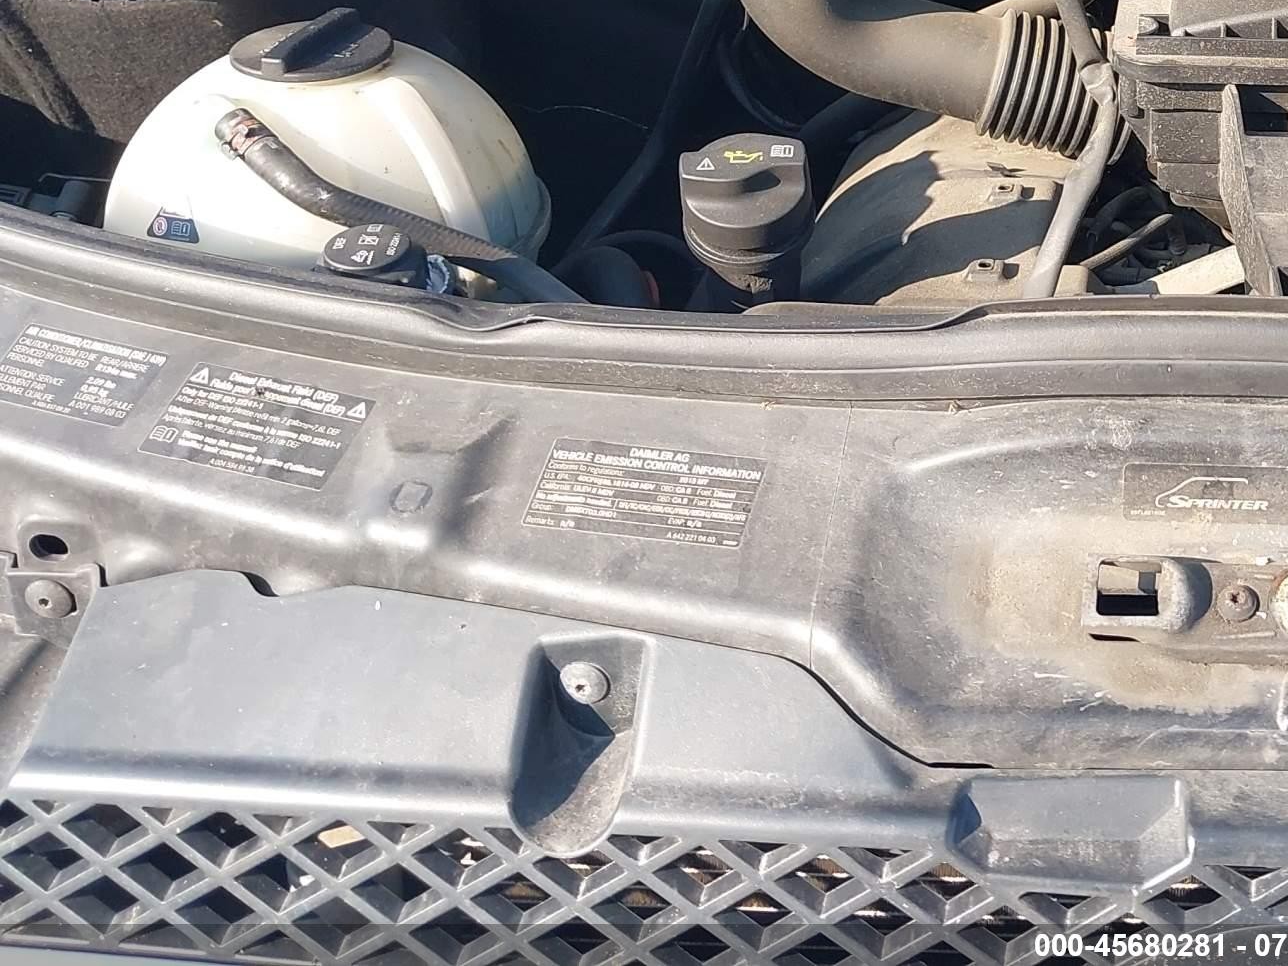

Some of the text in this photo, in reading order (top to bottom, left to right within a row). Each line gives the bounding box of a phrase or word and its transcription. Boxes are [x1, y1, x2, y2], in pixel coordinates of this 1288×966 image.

[49, 345, 80, 356] SYSTEM
[7, 352, 46, 367] PERSONNEL
[54, 355, 90, 368] QUALIFIED
[31, 382, 46, 390] PAR
[36, 374, 65, 386] SERVICE
[180, 387, 199, 396] Only
[207, 393, 224, 401] DEF
[228, 373, 258, 385] Diesel
[312, 391, 340, 404] (DEF)
[322, 404, 346, 417] (DEF)
[216, 416, 233, 425] DEF
[298, 434, 313, 442] ISO
[326, 428, 341, 436] DEF
[285, 441, 302, 449] DEF
[629, 448, 691, 462] DAIMLER AG
[548, 462, 579, 470] Conforms
[552, 450, 761, 480] VEHICLE EMISSION CONTROL INFORMATION
[713, 491, 736, 499] Diesel
[710, 501, 733, 509] Diesel
[1167, 496, 1269, 511] SPRINTER
